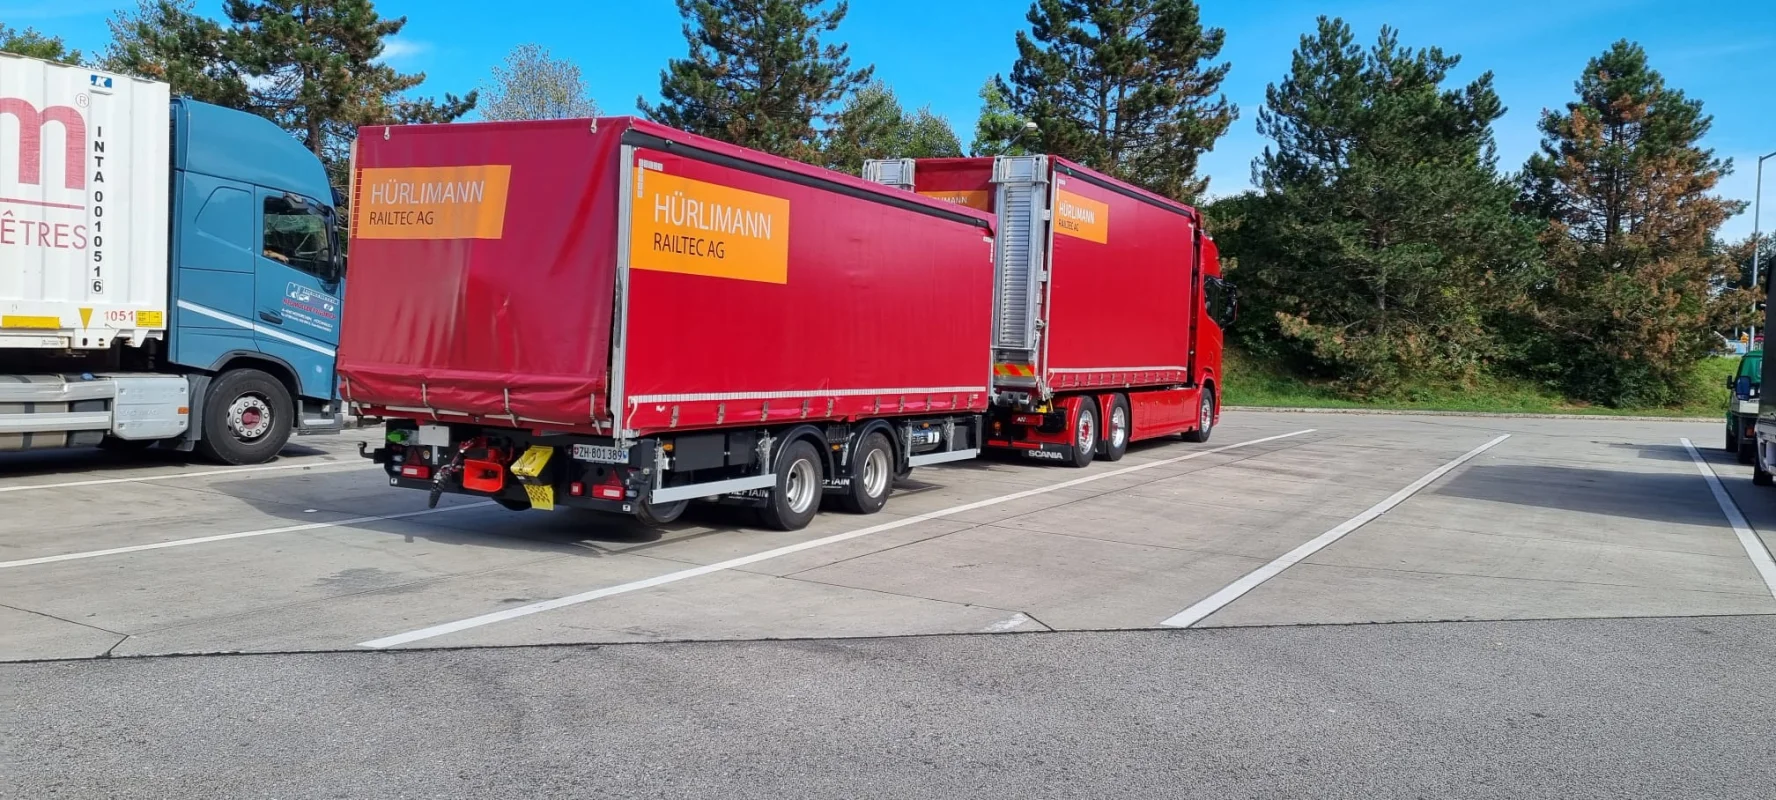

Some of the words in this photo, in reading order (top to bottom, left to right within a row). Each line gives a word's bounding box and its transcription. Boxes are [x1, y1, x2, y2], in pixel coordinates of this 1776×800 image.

[94, 126, 105, 183] INTA
[371, 178, 485, 205] HÜRLIMANN
[369, 211, 414, 226] RAILTEC
[416, 211, 434, 225] AG
[654, 190, 771, 240] HÜRLIMANN
[1059, 200, 1095, 225] HÜRLIMANN
[0, 210, 87, 250] ÊTRES
[653, 232, 704, 257] RAILTEC
[707, 240, 725, 259] AG
[104, 311, 134, 322] 1051
[1028, 450, 1063, 460] SCANIA
